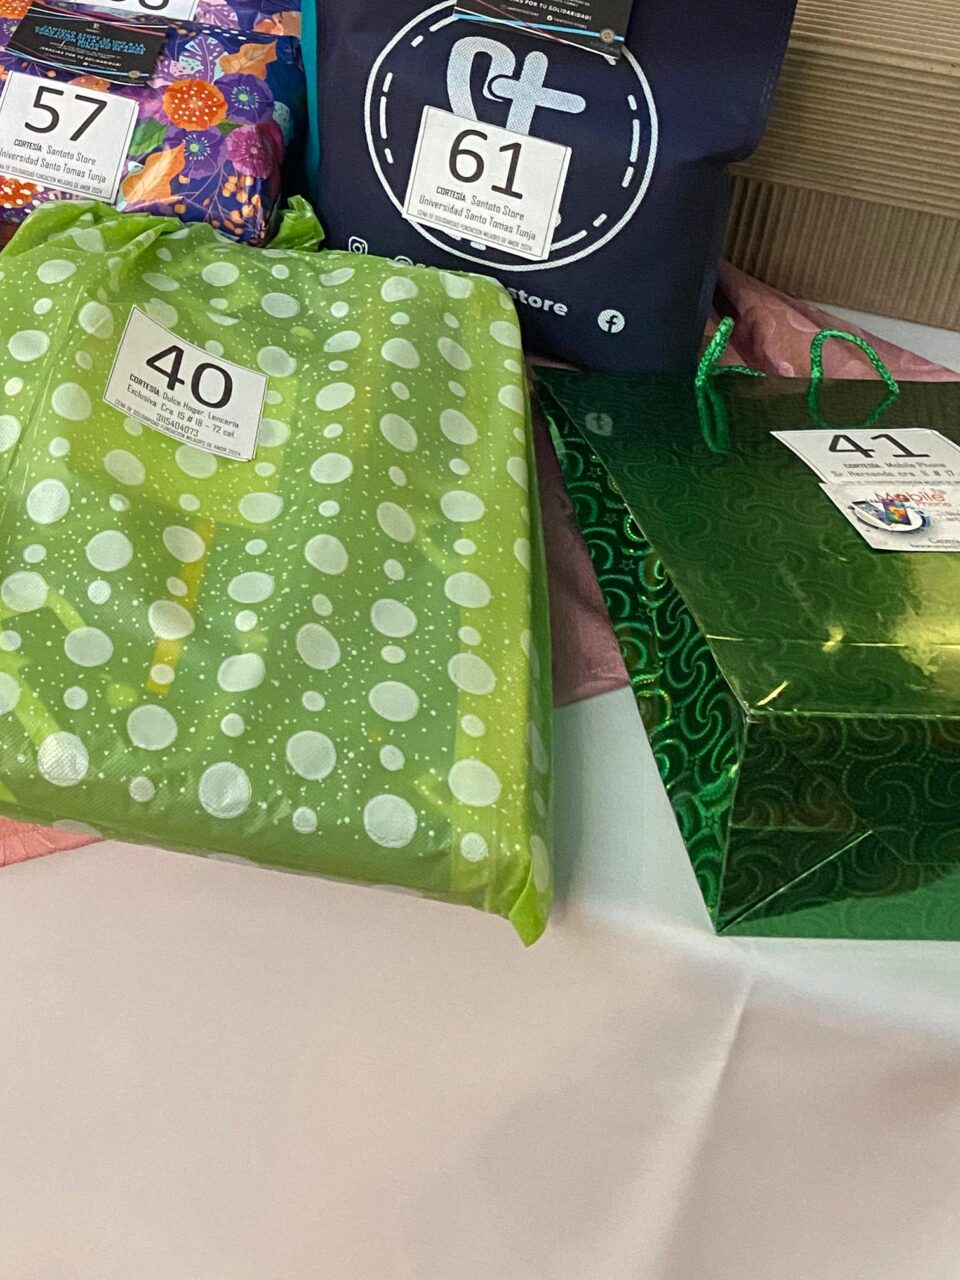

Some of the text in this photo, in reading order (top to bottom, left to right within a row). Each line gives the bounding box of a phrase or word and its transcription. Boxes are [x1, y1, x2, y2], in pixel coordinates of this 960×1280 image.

[25, 86, 107, 141] 57
[46, 145, 74, 160] Santoto
[75, 153, 96, 165] Store
[448, 129, 523, 199] 61
[40, 158, 61, 171] Santo
[63, 164, 85, 178] Tomas
[87, 170, 106, 184] Tunja
[419, 194, 537, 241] Universidad Santo Tomas Tunja
[471, 195, 501, 213] Santoto
[502, 205, 525, 221] Store
[146, 344, 233, 409] 40
[127, 384, 158, 408] Exclusiva
[177, 411, 185, 421] 15
[195, 419, 203, 427] 18
[212, 424, 221, 433] 72
[162, 392, 181, 406] Dulce
[155, 413, 199, 438] 3115404073
[828, 434, 930, 458] 41
